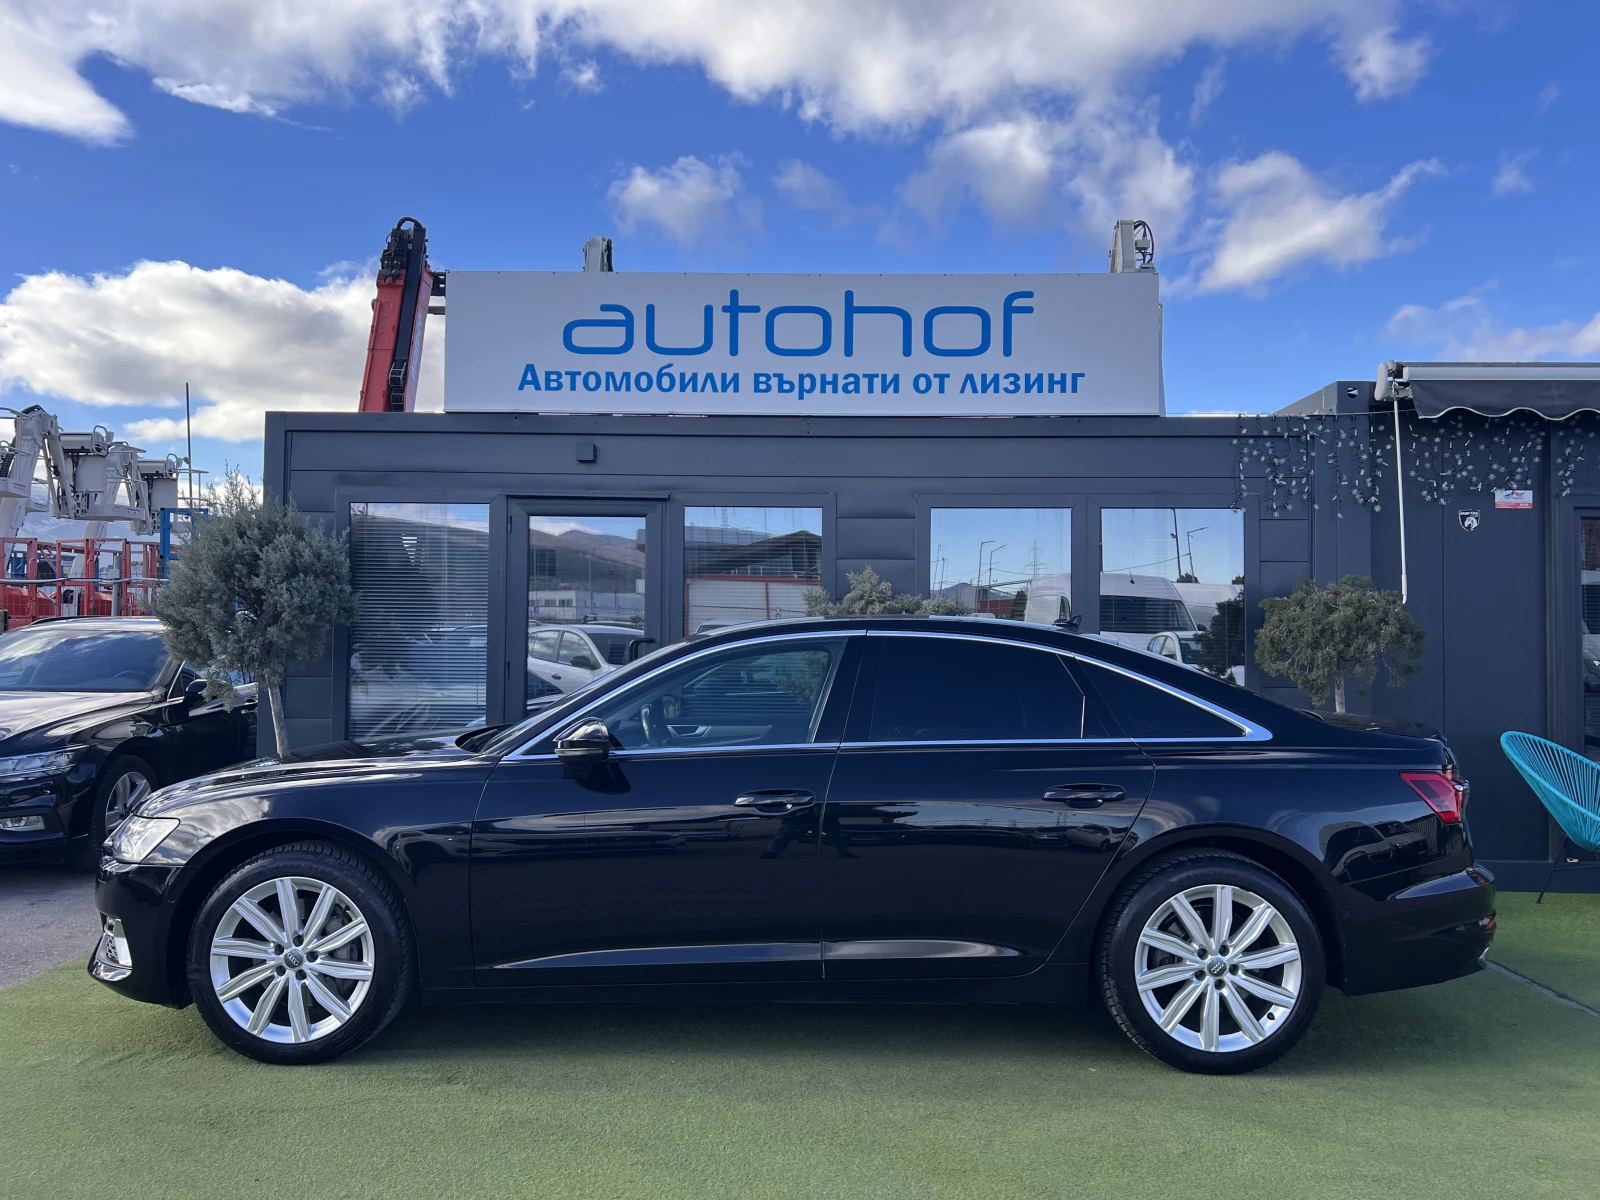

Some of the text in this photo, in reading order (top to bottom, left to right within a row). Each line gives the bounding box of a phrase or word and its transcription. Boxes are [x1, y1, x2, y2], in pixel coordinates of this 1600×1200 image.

[562, 289, 1035, 357] autohof
[517, 362, 1086, 401] Автомобили върнати от лизинг
